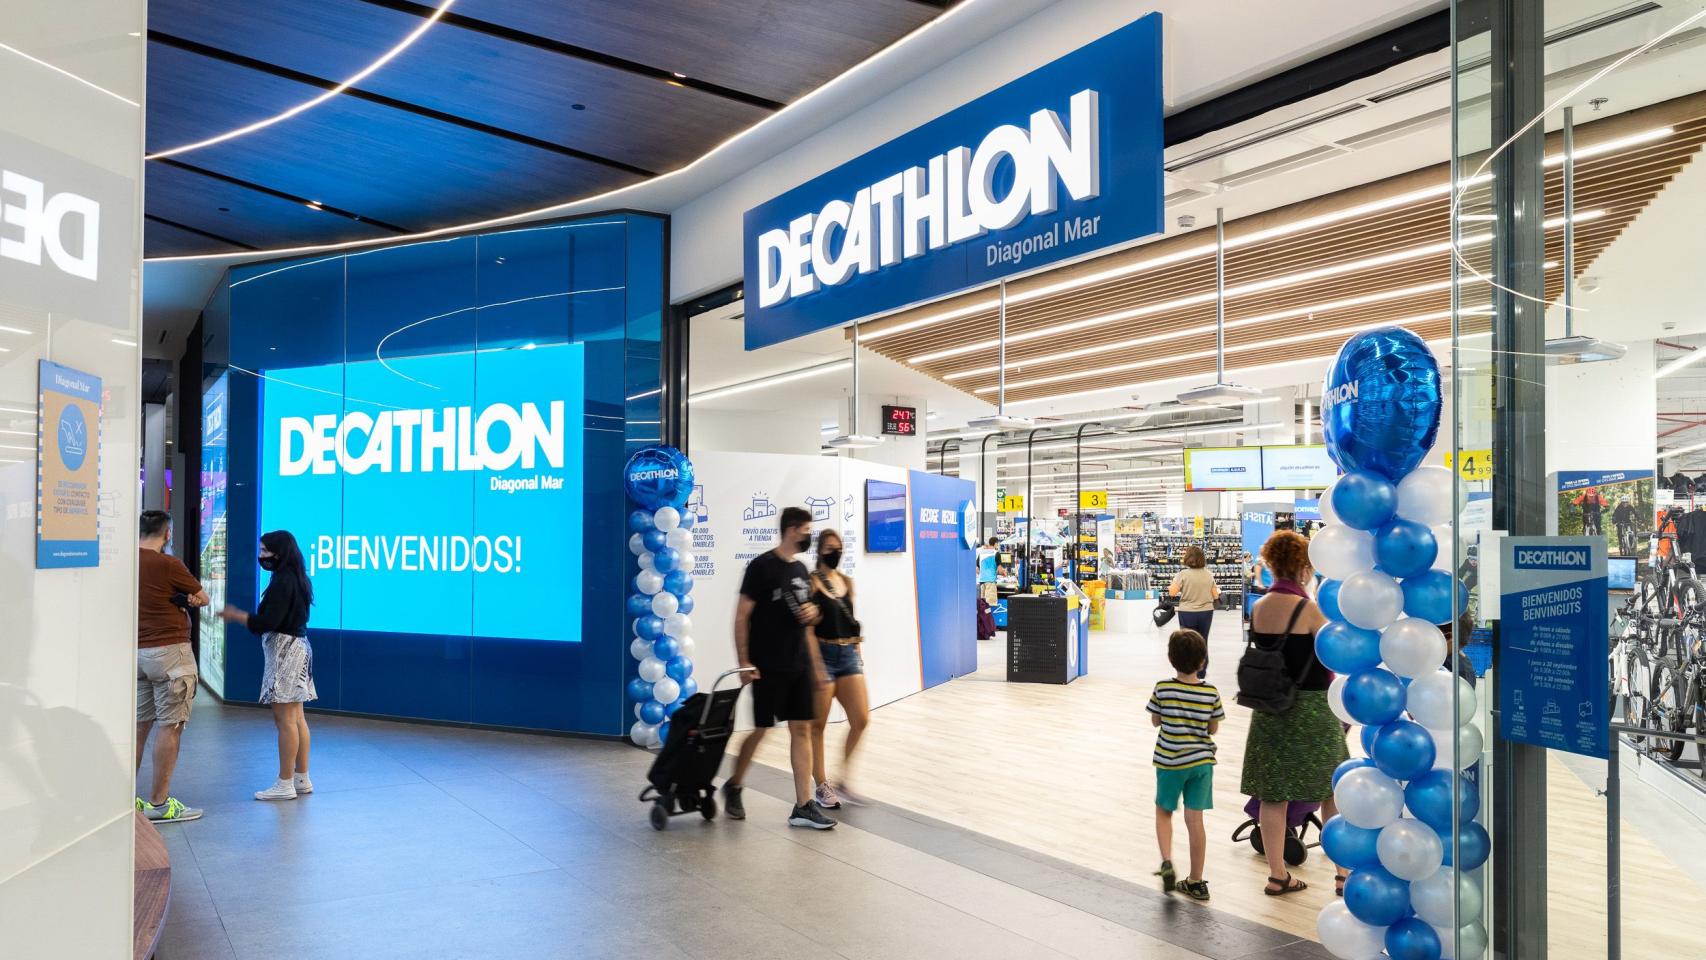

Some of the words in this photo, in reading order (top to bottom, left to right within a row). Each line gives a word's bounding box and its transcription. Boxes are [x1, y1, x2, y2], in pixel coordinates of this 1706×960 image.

[758, 88, 1099, 308] DECATHLON
[986, 222, 1058, 267] Diagonal
[1064, 215, 1101, 243] Mar
[279, 400, 564, 476] DECATHLON
[630, 468, 679, 482] DECATHLON
[1463, 456, 1476, 475] 4
[490, 475, 538, 494] Diagonal
[541, 475, 564, 491] Mar
[1091, 494, 1099, 506] 3
[310, 535, 522, 577] ¡BIENVENIDOS!
[1518, 550, 1587, 566] DECATHLON
[1522, 587, 1583, 608] BIENVENIDOS
[1523, 601, 1581, 621] BENVINGUTS
